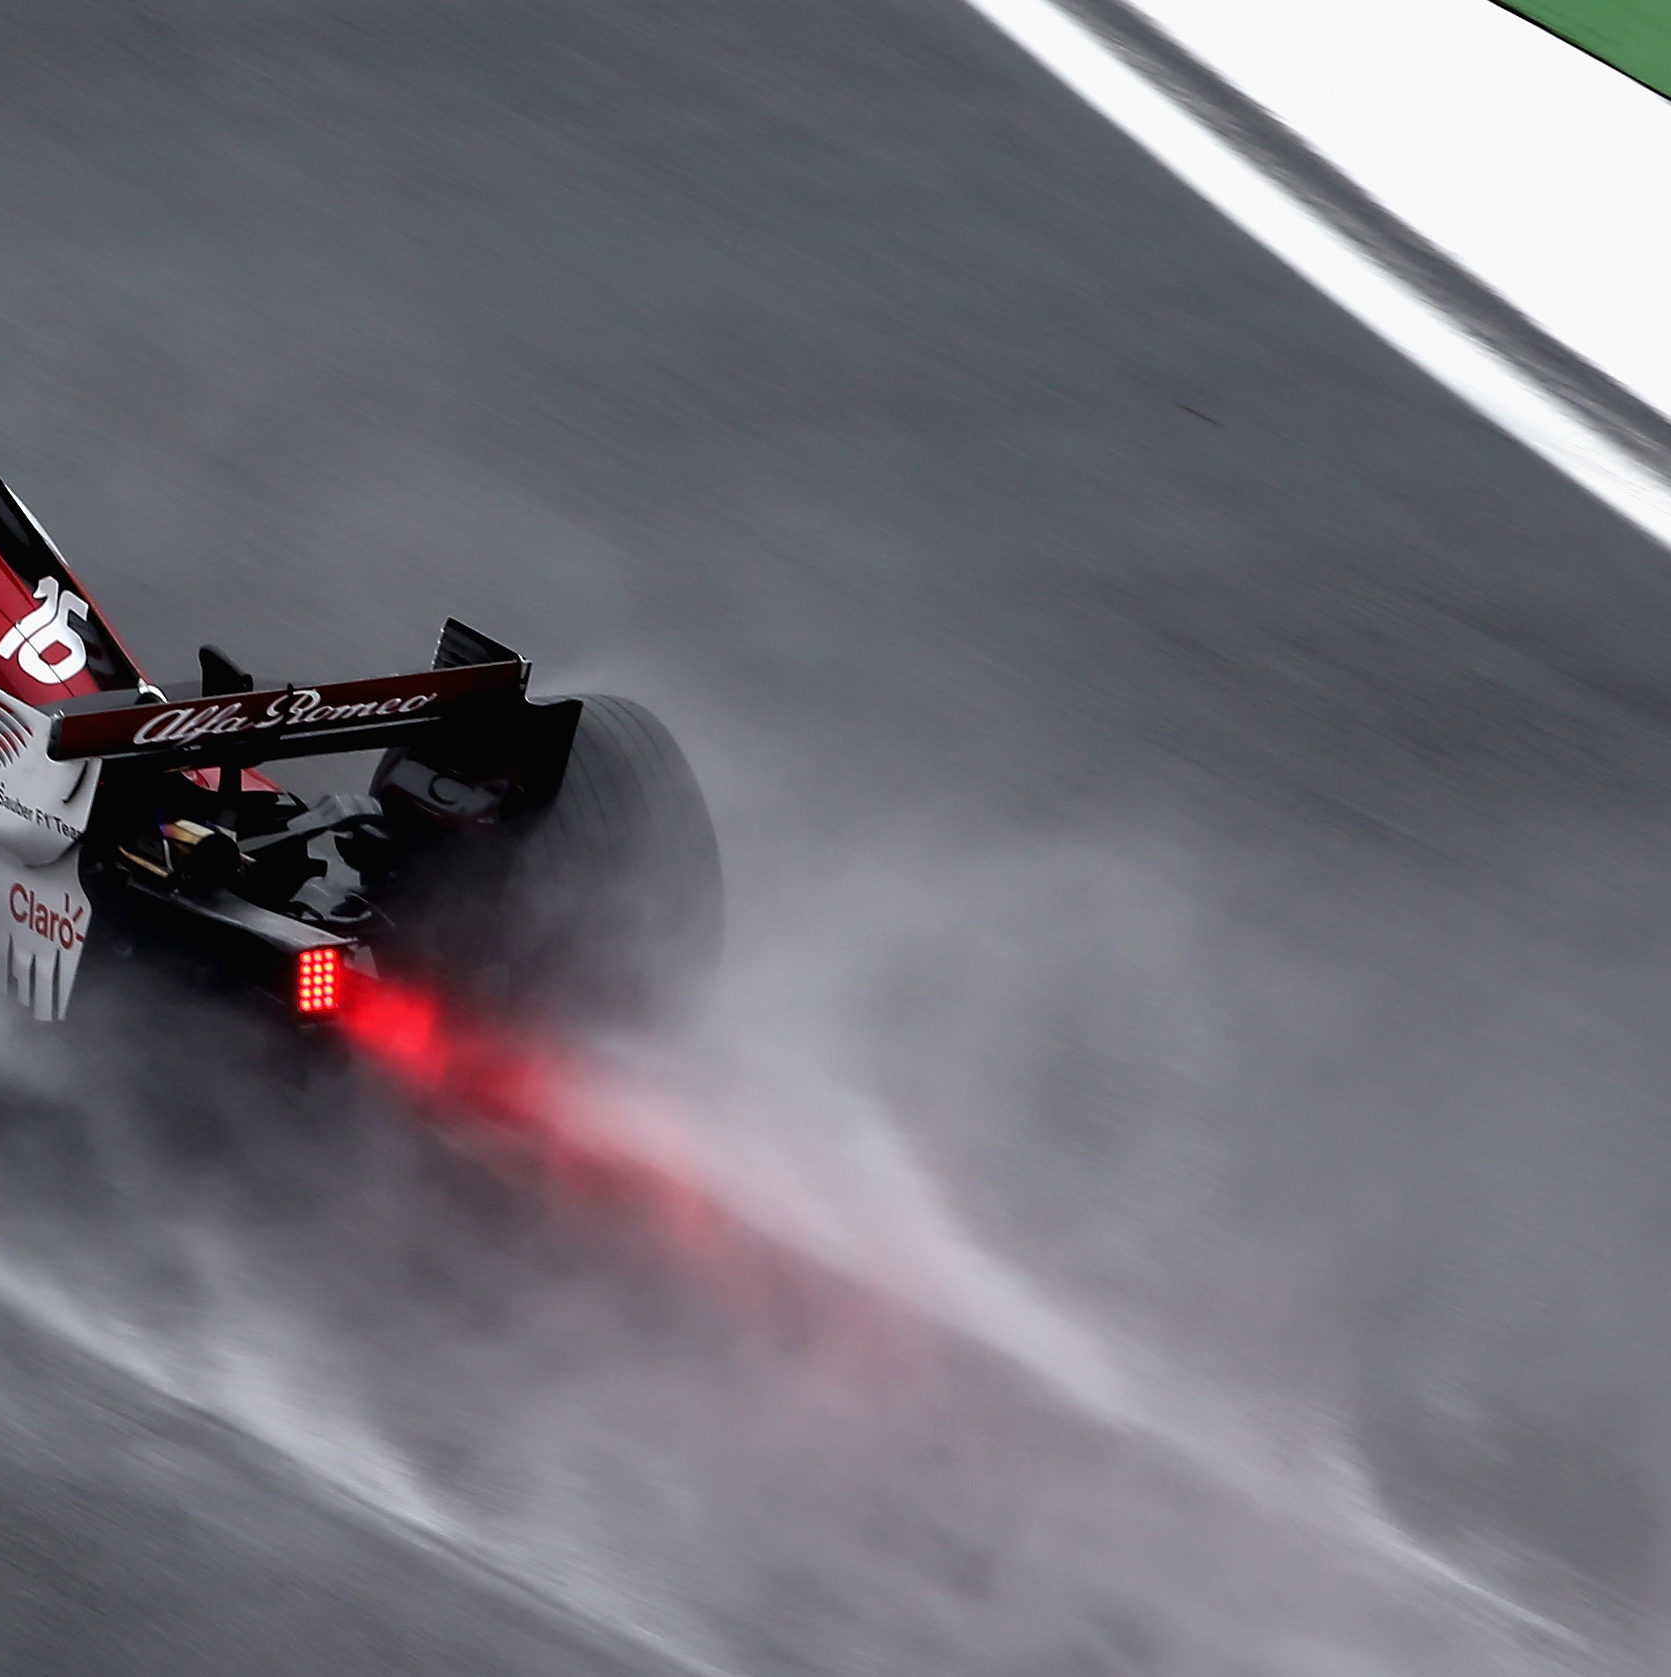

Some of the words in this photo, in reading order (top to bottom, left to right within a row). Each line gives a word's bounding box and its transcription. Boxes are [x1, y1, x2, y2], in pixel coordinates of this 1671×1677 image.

[133, 700, 249, 747] Alfa
[254, 688, 439, 729] Romeo
[35, 808, 51, 830] F1
[10, 882, 76, 950] Claro
